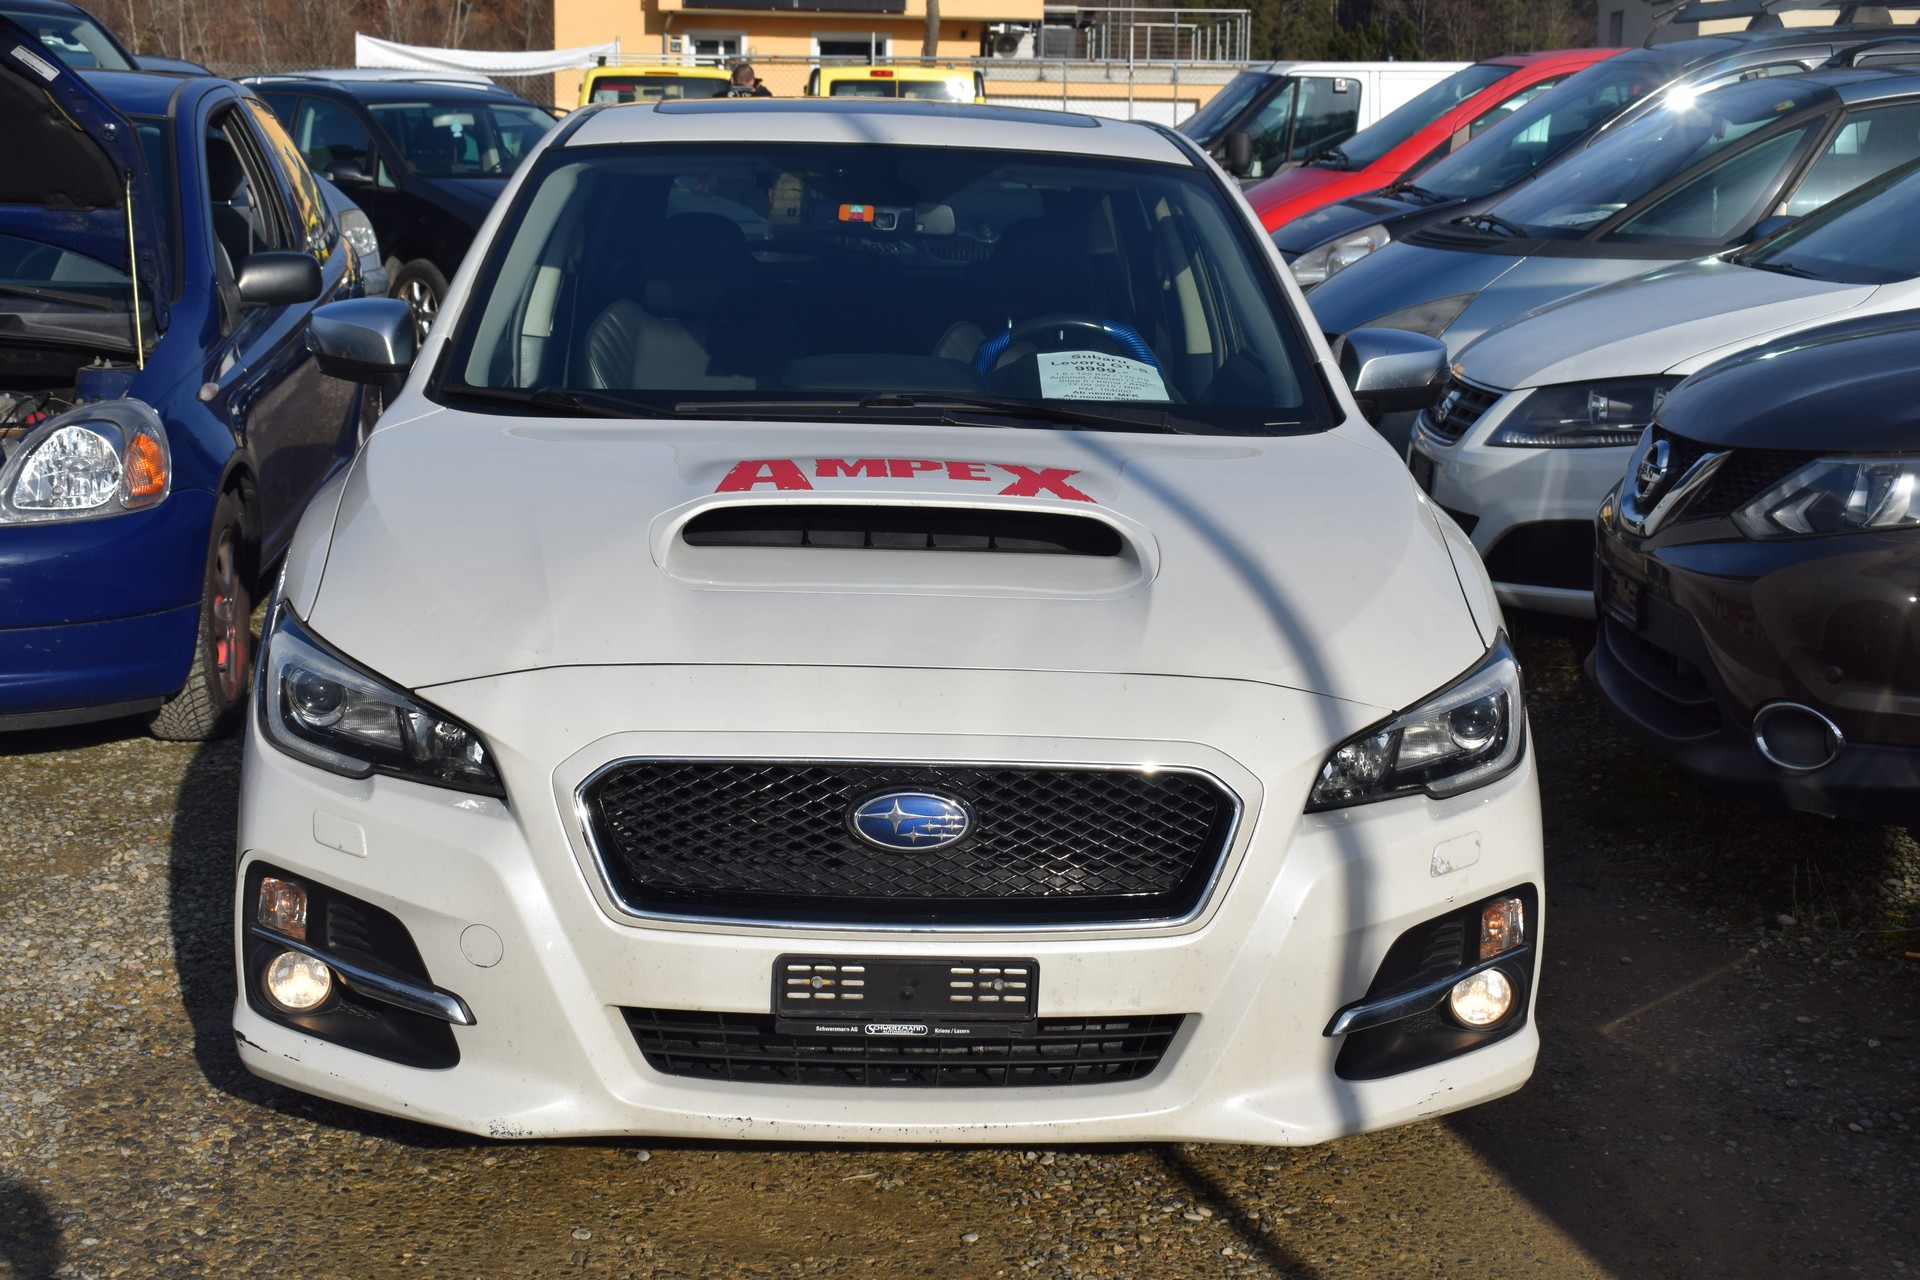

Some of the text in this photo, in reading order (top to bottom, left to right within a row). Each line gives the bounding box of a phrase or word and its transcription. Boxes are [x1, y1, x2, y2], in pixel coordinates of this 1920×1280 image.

[1071, 354, 1127, 364] Subaru
[1111, 362, 1132, 370] GT
[714, 458, 1100, 504] AMPEX
